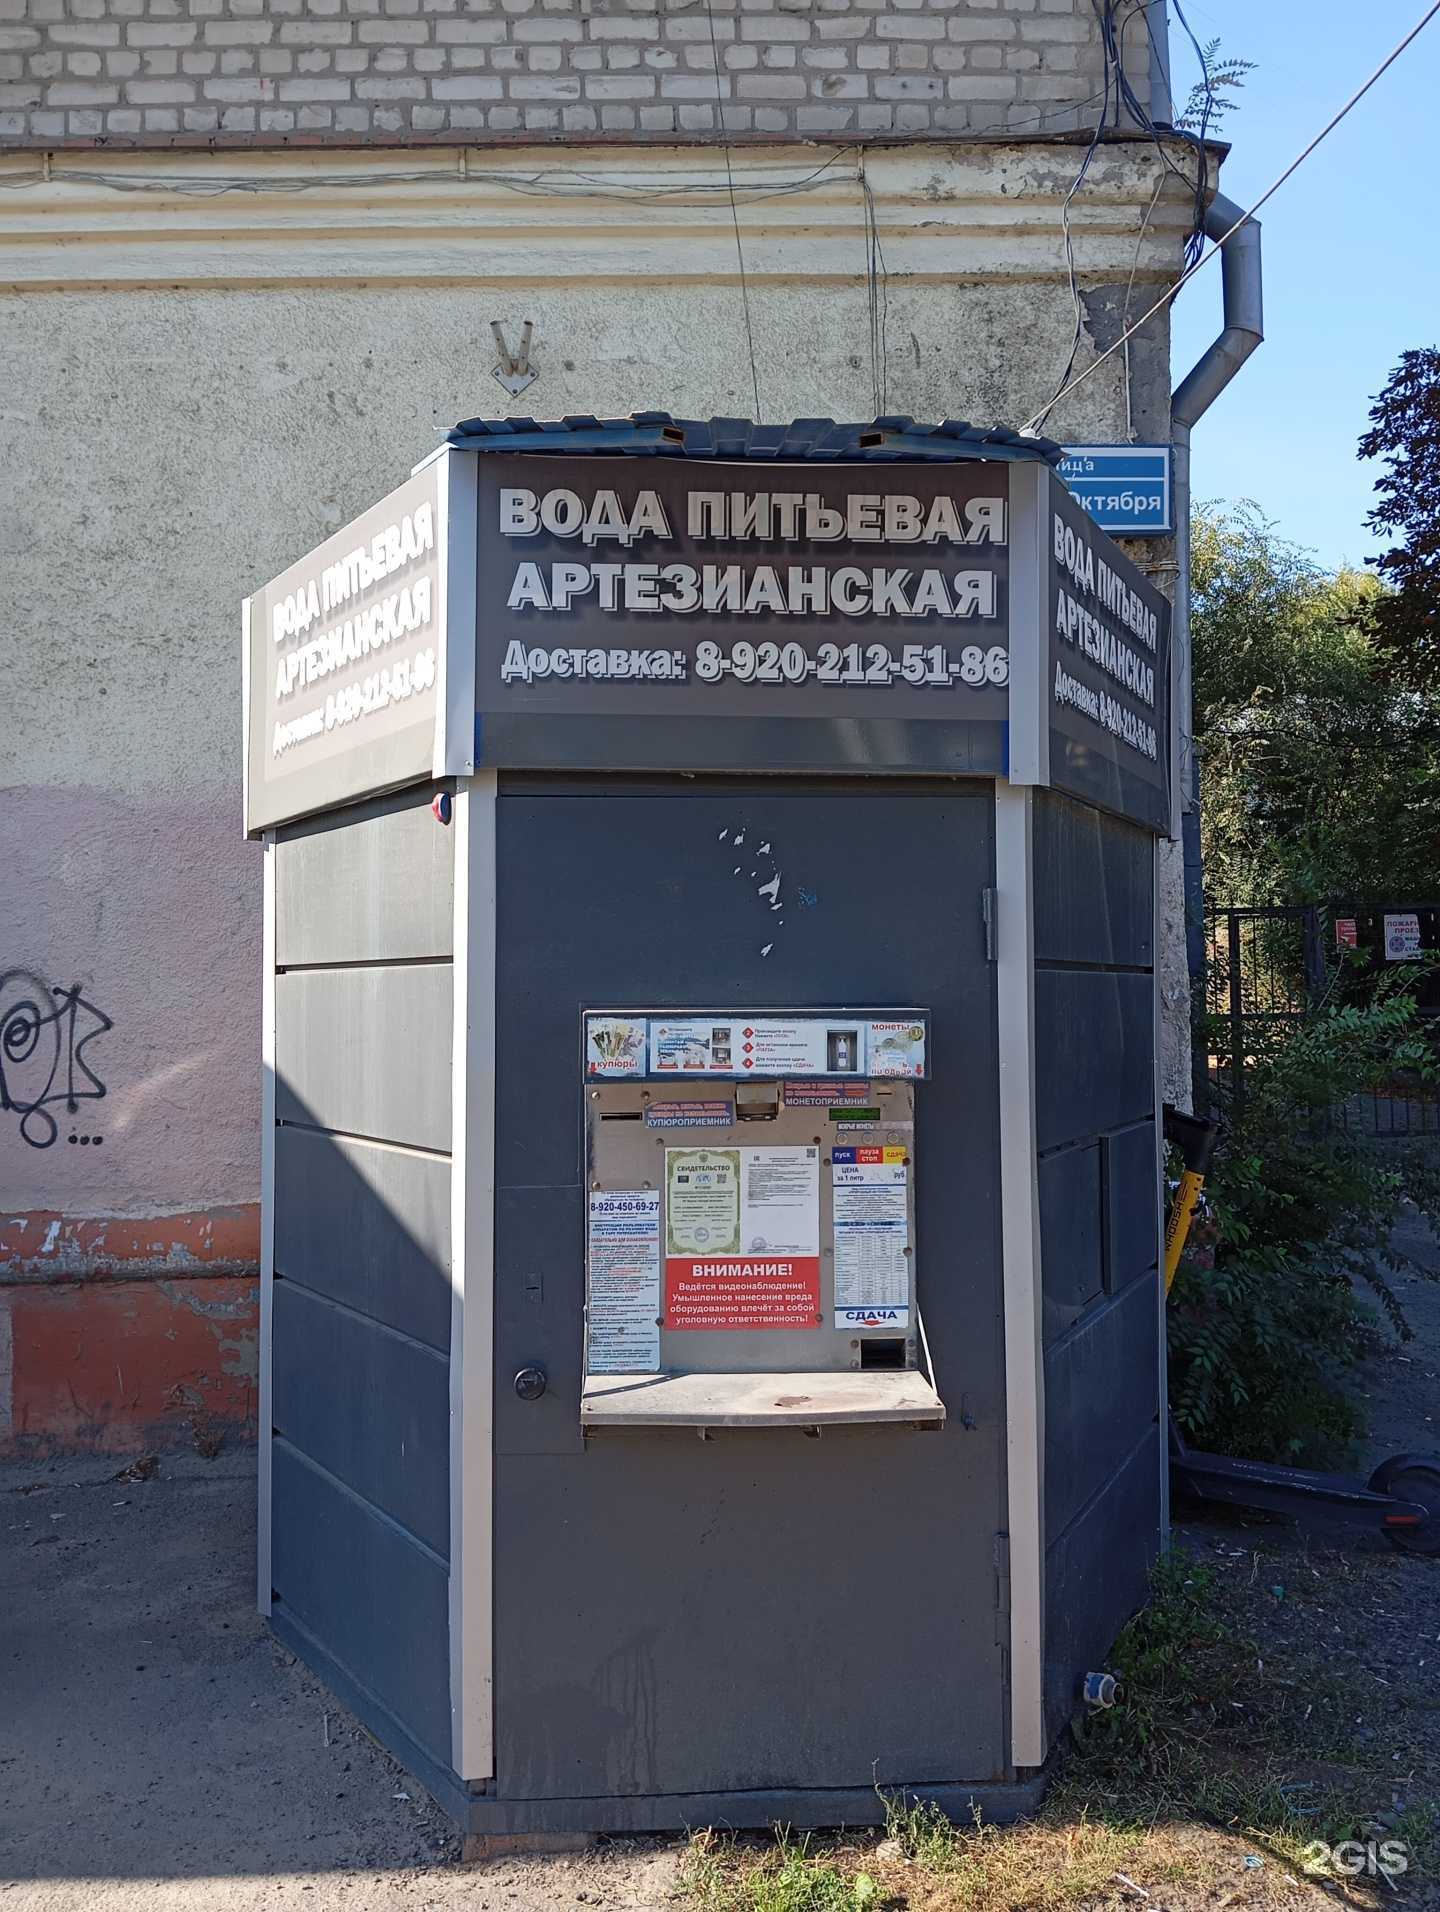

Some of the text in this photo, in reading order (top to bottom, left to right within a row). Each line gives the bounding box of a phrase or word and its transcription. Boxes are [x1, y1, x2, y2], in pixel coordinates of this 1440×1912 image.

[500, 488, 1008, 547] ВОДА ПИТЬЕВАЯ
[272, 501, 435, 643] ВОДА ПИТЬЕВАЯ
[1054, 513, 1157, 653] ВОДА ПИТЬЕВАЯ
[507, 562, 998, 618] АРТЕЗИАНСКАЯ
[275, 575, 432, 700] АРТЕЗИАНСКАЯ
[1056, 588, 1155, 709] АРТЕЗИАНСКАЯ
[501, 640, 1009, 687] Доставка: 8-920-212-51-86
[871, 1023, 910, 1032] монеты
[597, 1060, 638, 1070] купюры
[785, 1097, 869, 1106] МОНЕТОПРИЕМНИК
[647, 1117, 731, 1127] КУПЮРОПРИЕМНИК
[677, 1165, 731, 1173] СВИДЕТЕЛЬСТВО
[591, 1201, 660, 1212] 8-920-450-69-27
[692, 1263, 793, 1278] ВНИМАНИЕ!
[678, 1281, 807, 1292] Ведётся видеонаблюдение!
[671, 1293, 813, 1302] Умышленное нанесение вреда
[670, 1305, 739, 1314] оборудованию
[741, 1303, 772, 1312] влечёт
[786, 1302, 815, 1312] собой
[676, 1314, 808, 1325] уголовную ответственность!
[845, 1310, 898, 1321] СДАЧА
